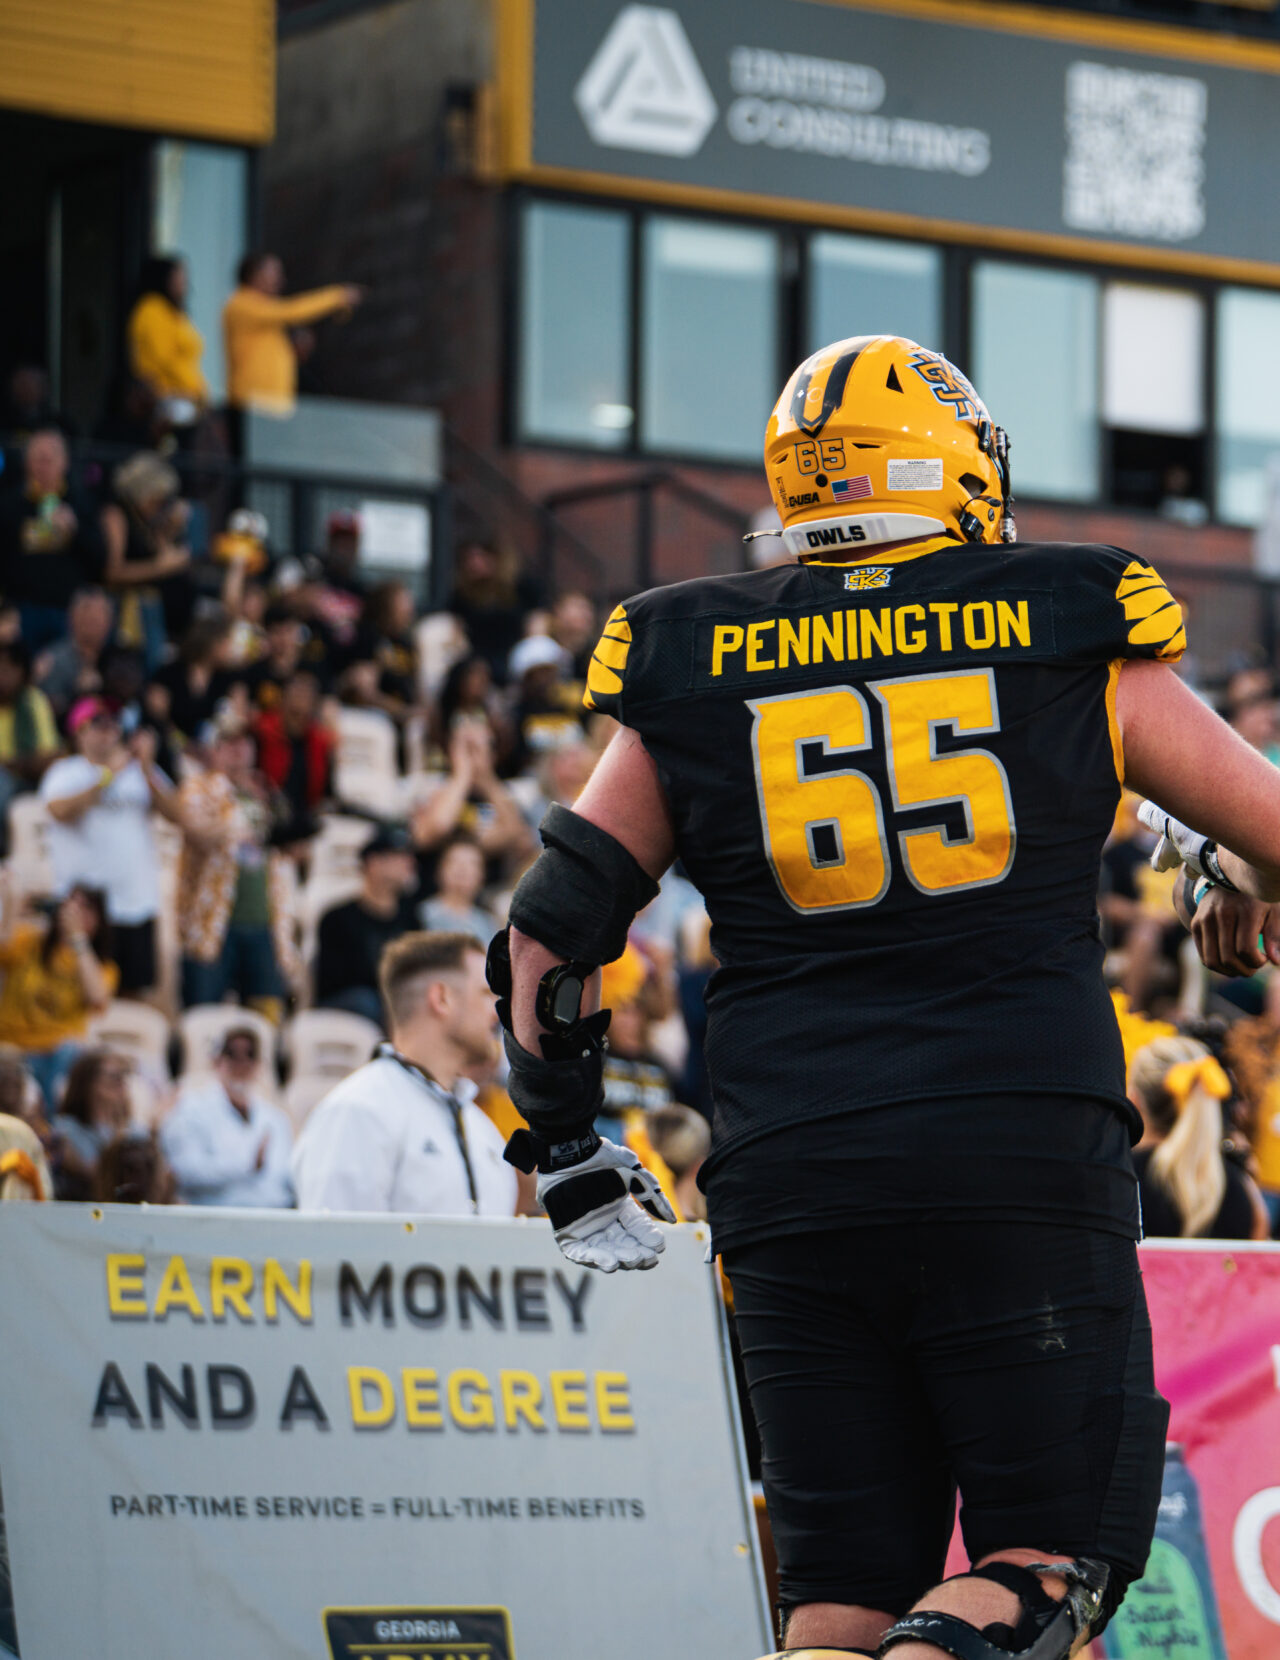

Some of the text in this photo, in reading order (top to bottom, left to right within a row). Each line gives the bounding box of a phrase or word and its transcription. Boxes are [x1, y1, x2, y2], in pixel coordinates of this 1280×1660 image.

[728, 46, 886, 112] UNITED
[726, 97, 991, 177] CONSULTING
[794, 438, 847, 476] 65
[806, 525, 866, 548] OWLS
[710, 600, 1032, 677] PENNINGTON
[745, 667, 1018, 915] 65
[107, 1253, 594, 1332] EARN MONEY
[94, 1361, 637, 1432] AND A DEGREE
[111, 1494, 646, 1521] PART-TIME SERVICE = FULL-TIME BENEFITS
[375, 1619, 461, 1640] GEORGIA
